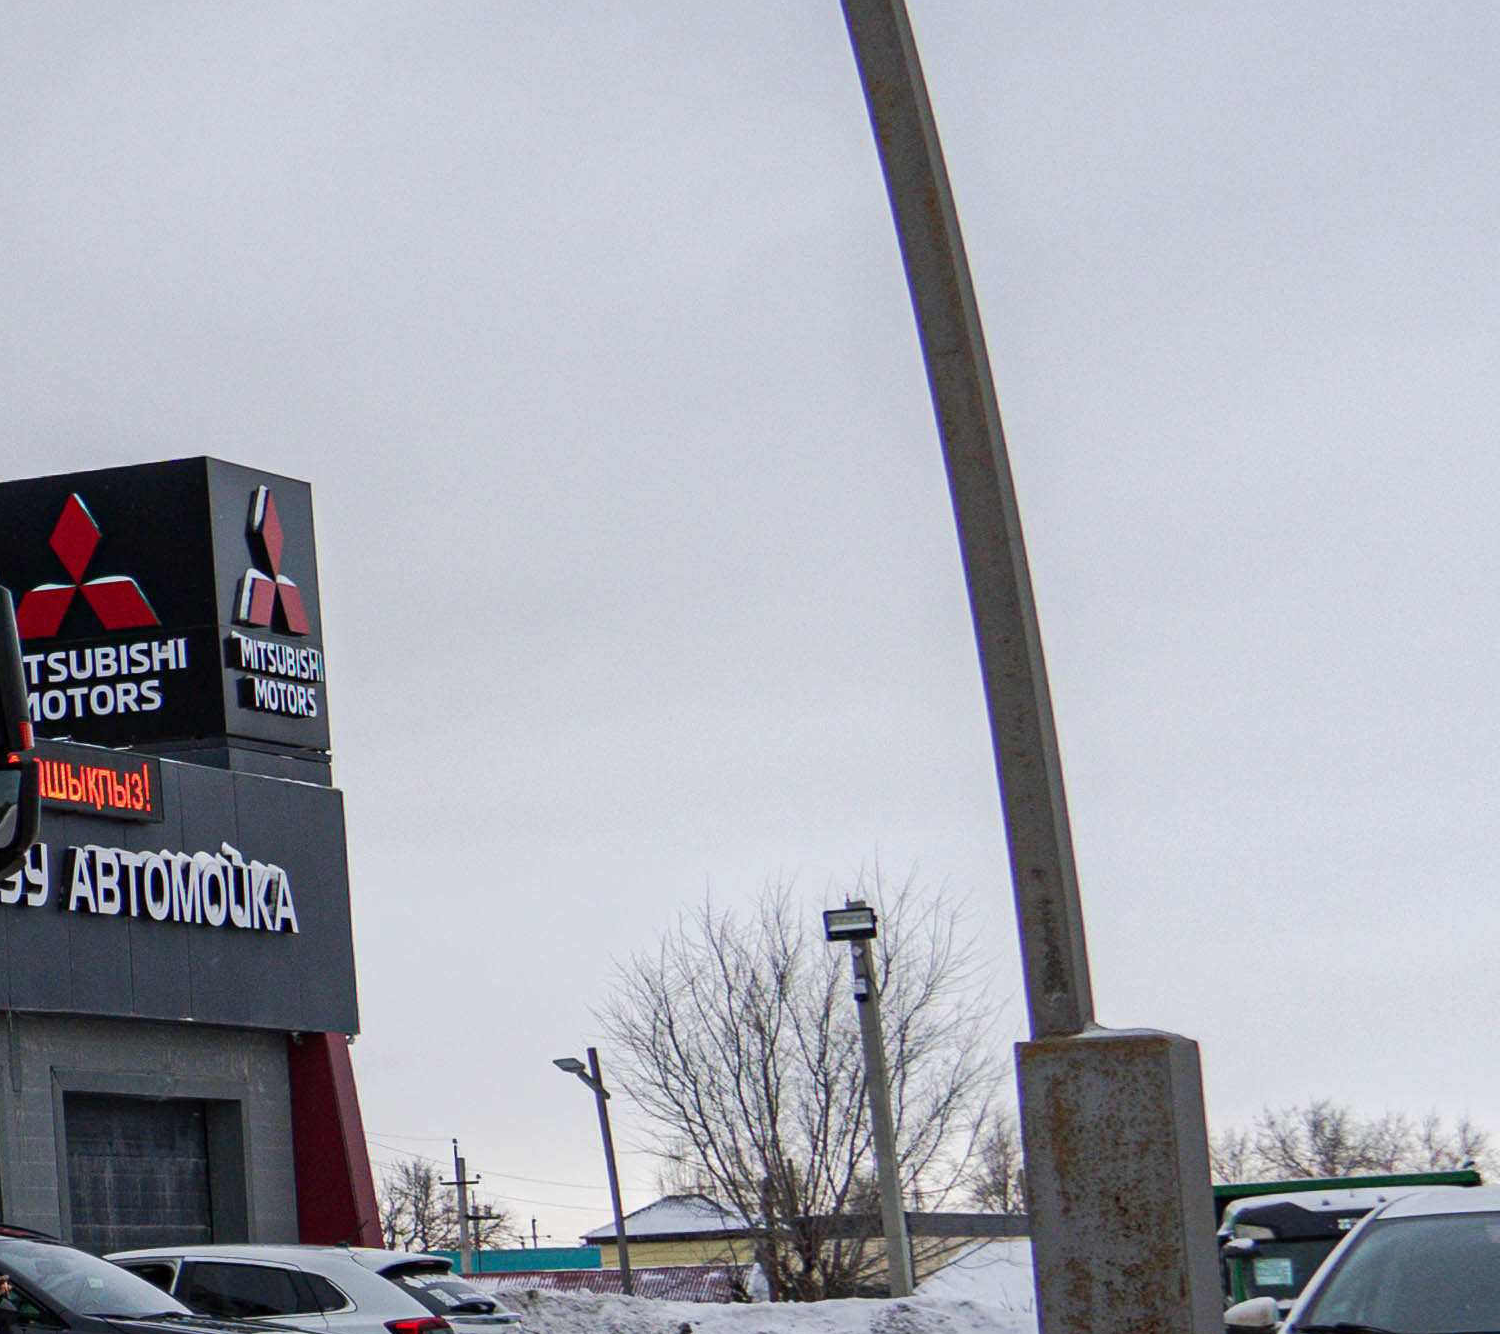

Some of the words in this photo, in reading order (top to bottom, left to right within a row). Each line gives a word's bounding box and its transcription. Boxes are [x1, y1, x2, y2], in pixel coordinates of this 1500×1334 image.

[22, 638, 188, 685] TSUBISHI
[239, 636, 324, 682] MITSUBISHI
[254, 676, 317, 718] MOTORS
[67, 843, 300, 935] АВТОМОЙКА
